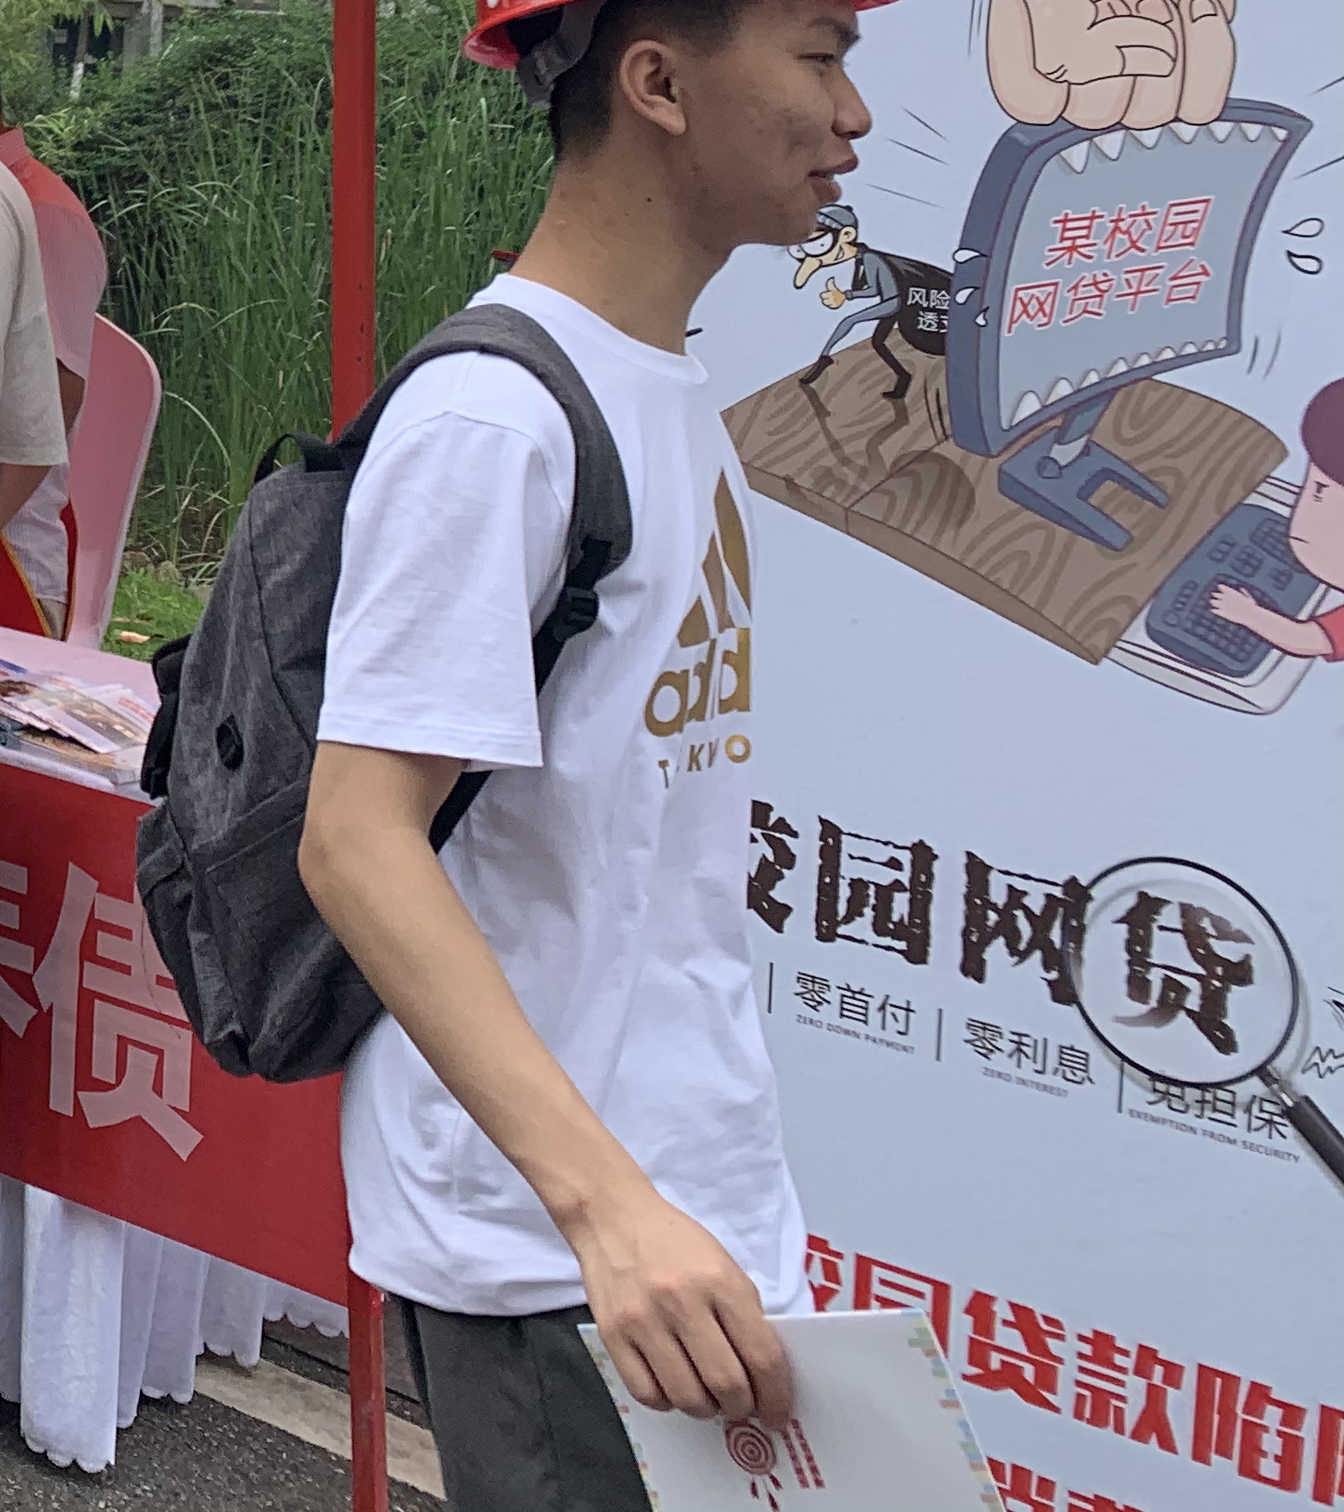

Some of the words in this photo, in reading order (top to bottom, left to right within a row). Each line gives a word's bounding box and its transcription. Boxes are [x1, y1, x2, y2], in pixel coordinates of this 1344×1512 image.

[1043, 195, 1215, 270] 某校园
[907, 287, 951, 310] 风险
[1005, 257, 1213, 336] 网贷平台
[793, 971, 917, 1037] 零首付
[795, 1013, 823, 1030] ZERO
[826, 1022, 861, 1040] DOWN
[864, 1033, 915, 1055] PAYMENT
[963, 1017, 1096, 1086] 零利息
[982, 1066, 1012, 1083] ZERO
[1015, 1076, 1069, 1097] INTEREST
[1128, 1108, 1197, 1136] EXEMPTION
[1201, 1128, 1238, 1146] FROM
[1242, 1139, 1301, 1164] SECURITY
[1146, 1076, 1289, 1140] 免担保
